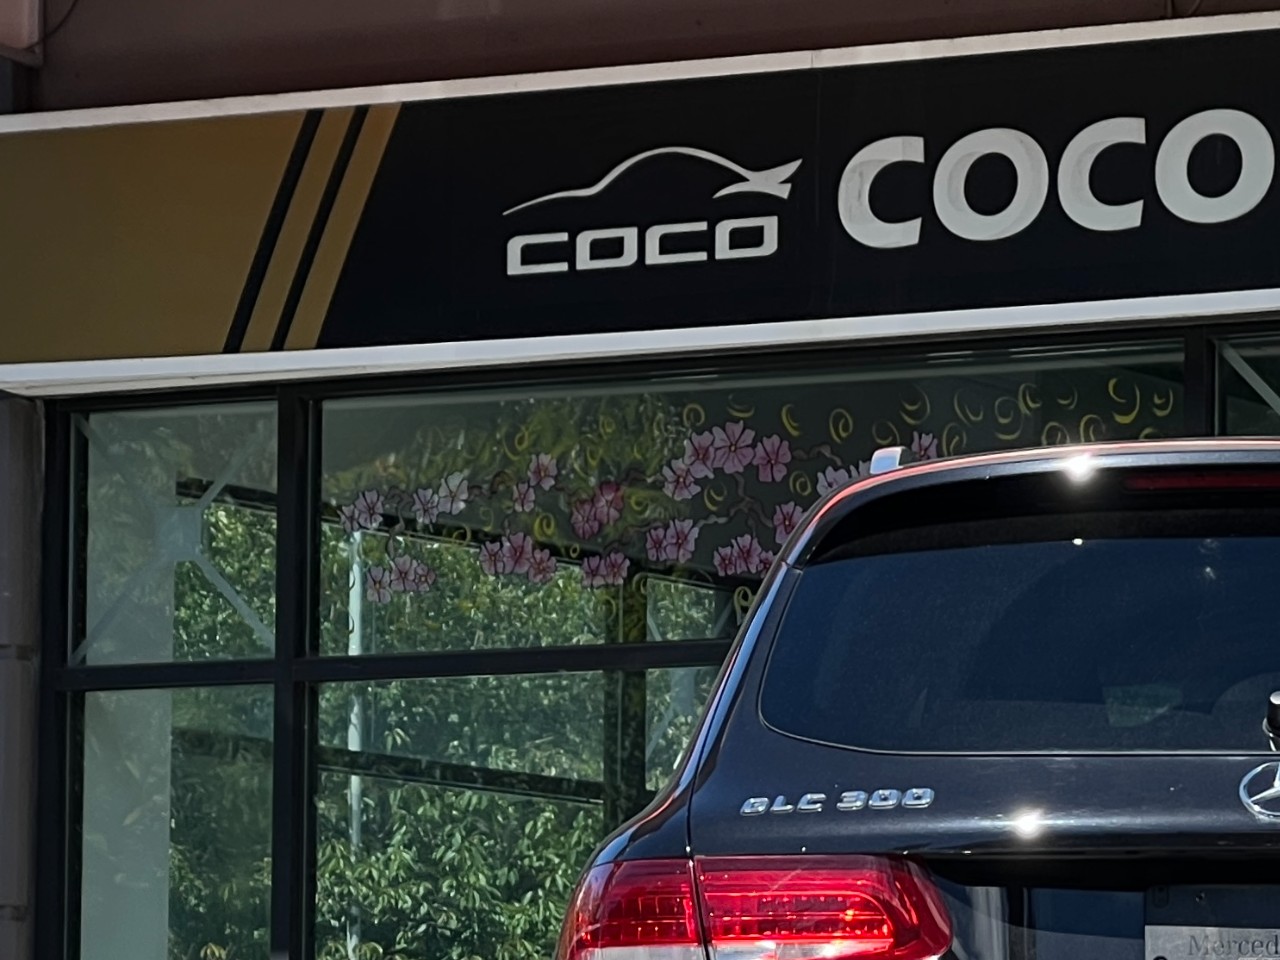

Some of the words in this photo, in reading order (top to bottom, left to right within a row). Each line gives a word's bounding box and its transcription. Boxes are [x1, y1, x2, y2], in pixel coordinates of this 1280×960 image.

[837, 108, 1275, 249] COCO
[506, 215, 779, 276] COCO
[740, 793, 826, 816] GLC
[836, 788, 935, 811] 300
